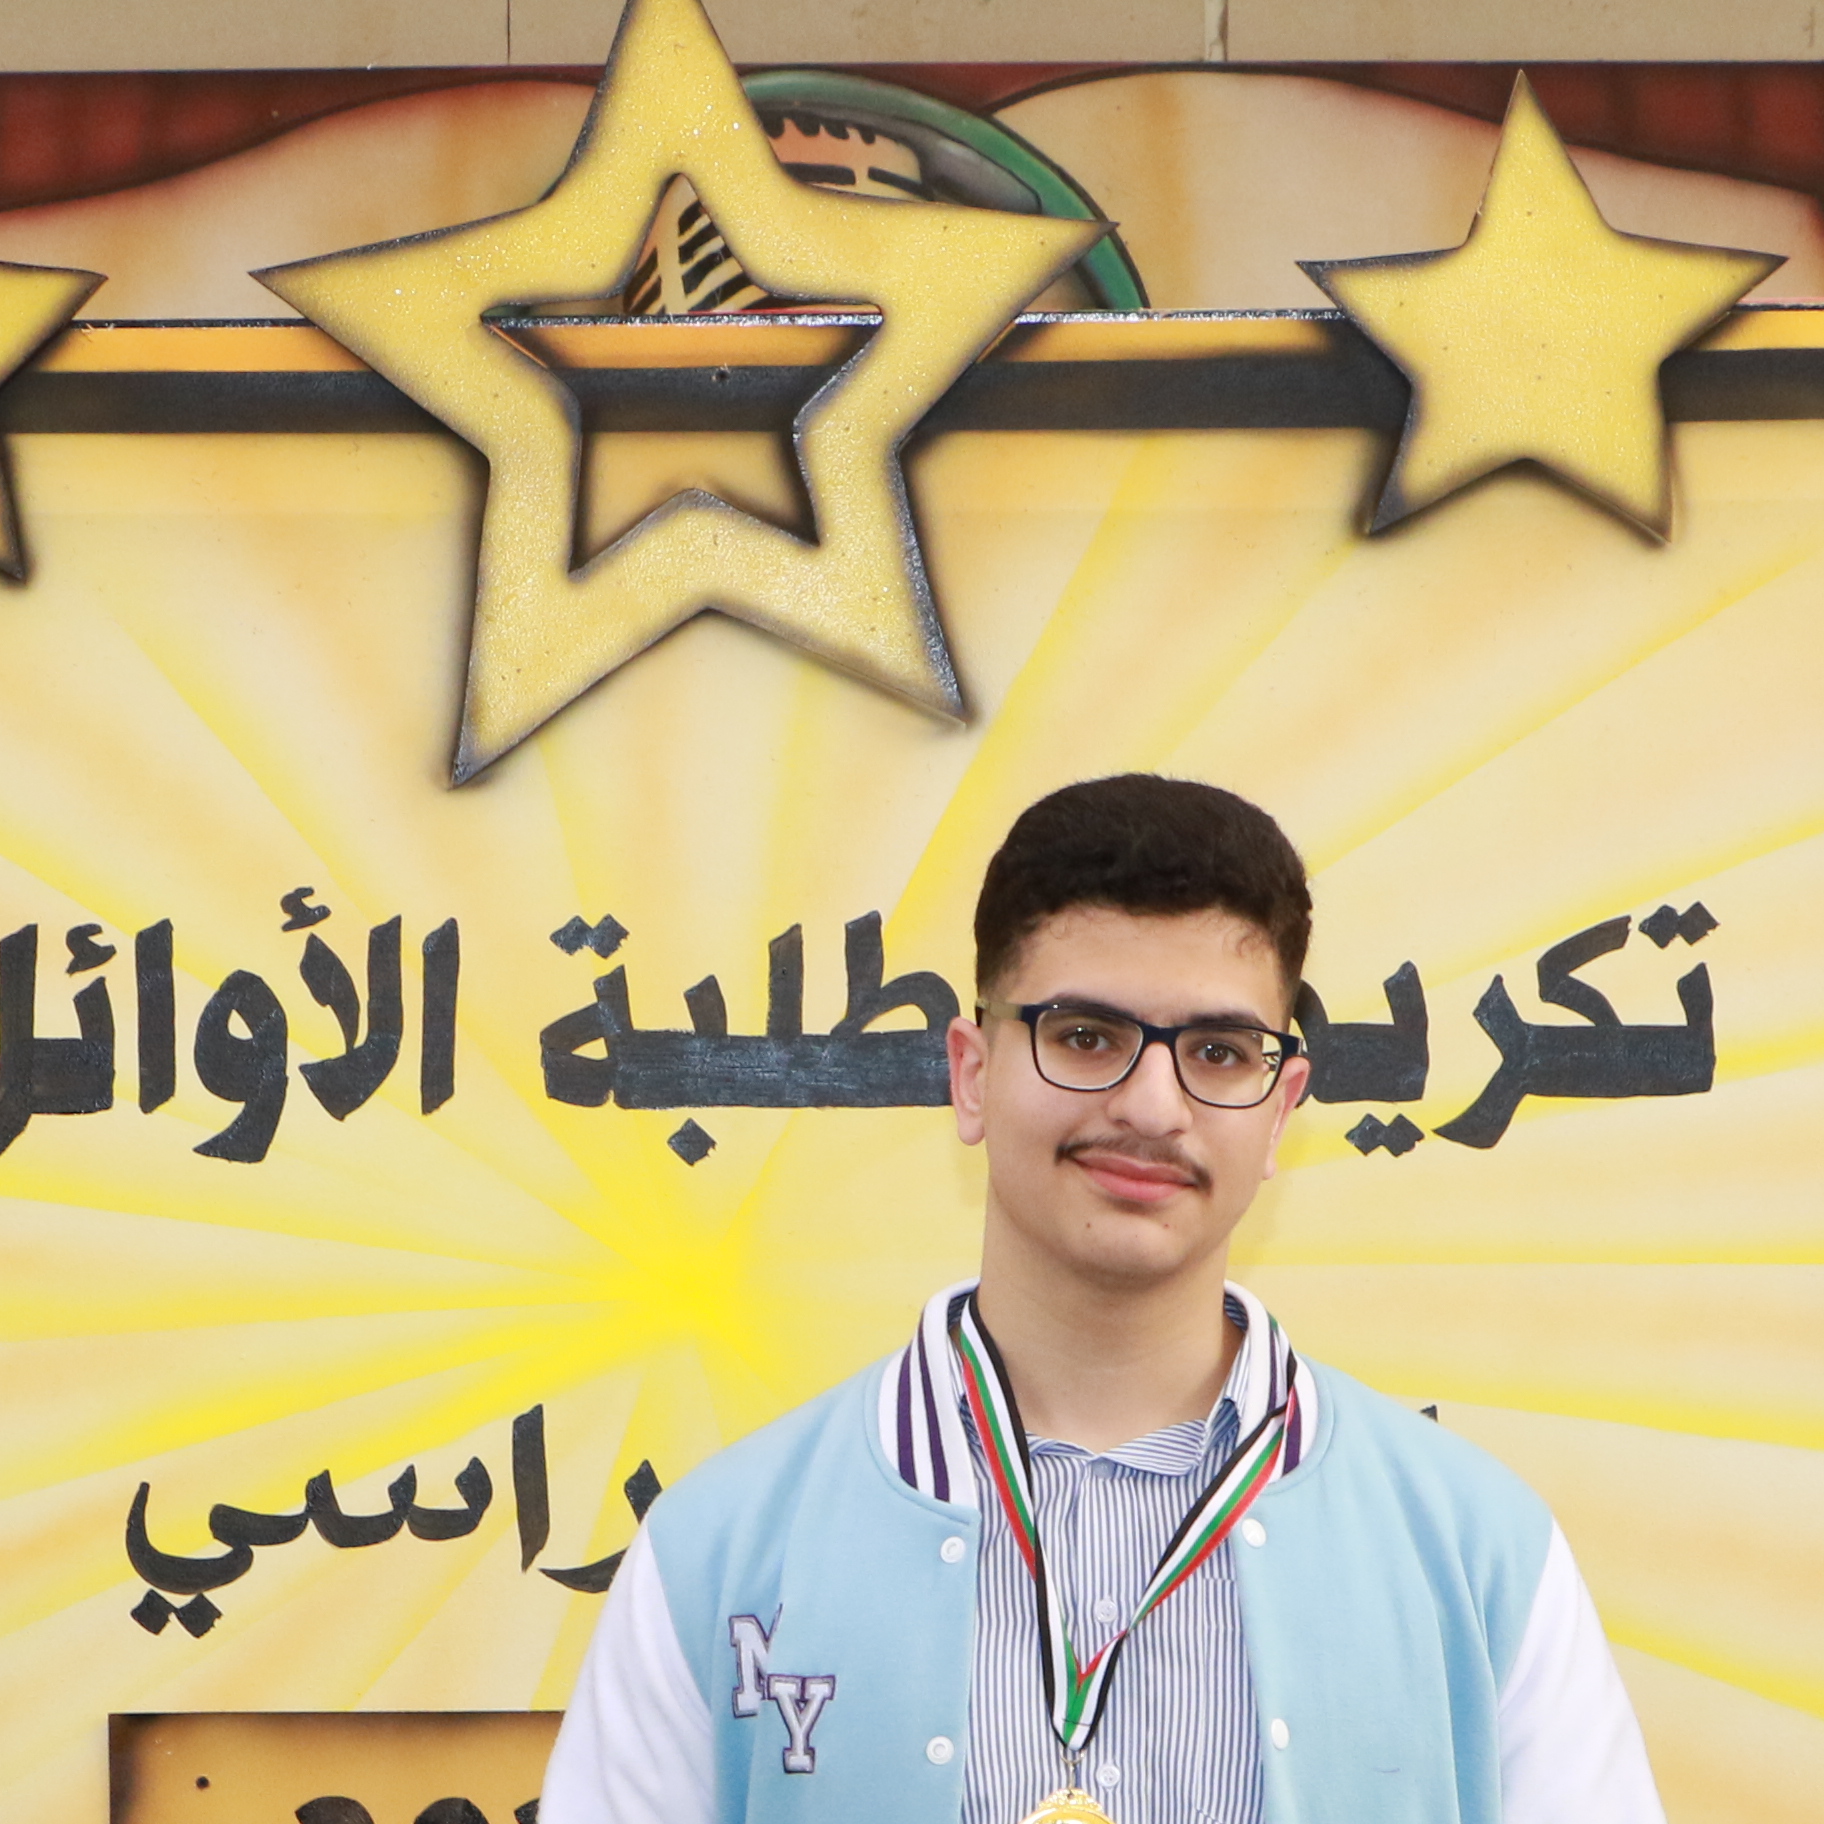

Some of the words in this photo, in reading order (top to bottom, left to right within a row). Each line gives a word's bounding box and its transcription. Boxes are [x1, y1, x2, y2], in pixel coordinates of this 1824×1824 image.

[540, 910, 960, 1166] طلبة
[1293, 900, 1720, 1158] تكري
[125, 1402, 663, 1639] راسي
